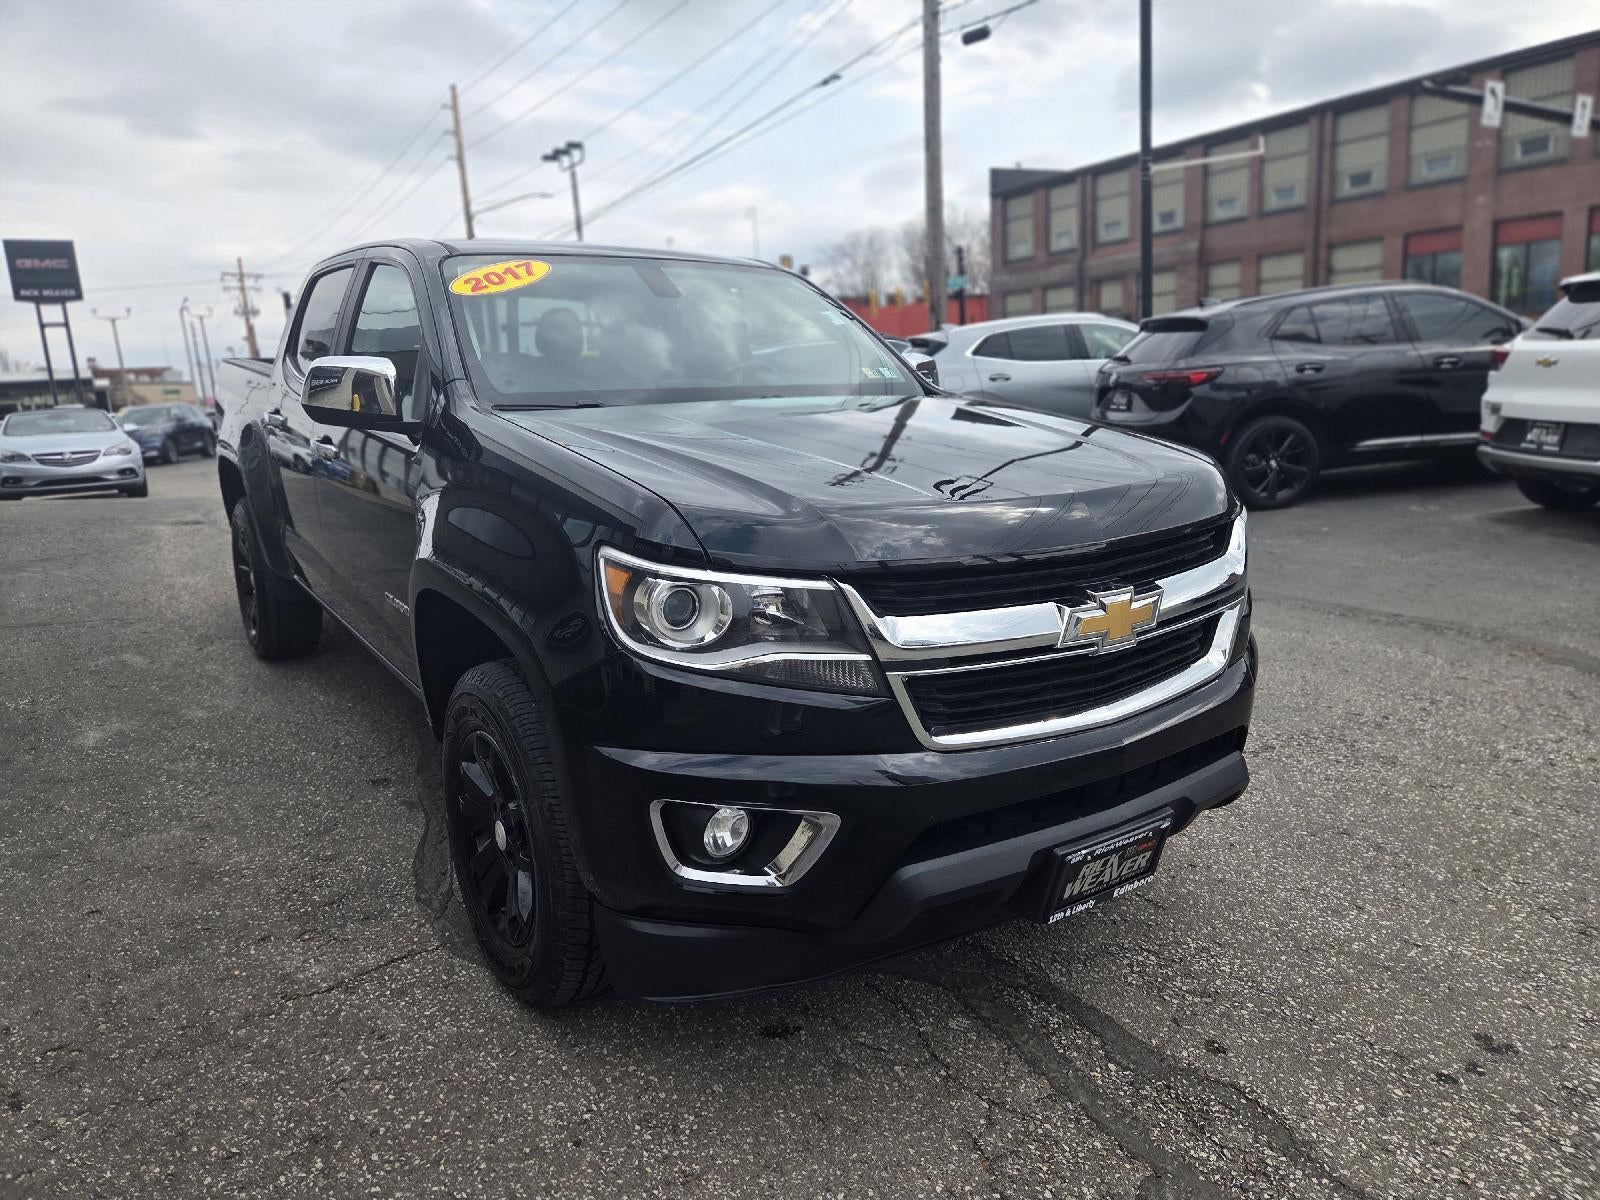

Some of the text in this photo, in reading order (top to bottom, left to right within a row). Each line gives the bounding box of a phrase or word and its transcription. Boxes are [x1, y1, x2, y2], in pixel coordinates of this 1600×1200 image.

[15, 258, 69, 269] GMC
[463, 262, 535, 293] 2017
[1062, 850, 1153, 899] WEAVER
[1113, 875, 1154, 898] Edinboro
